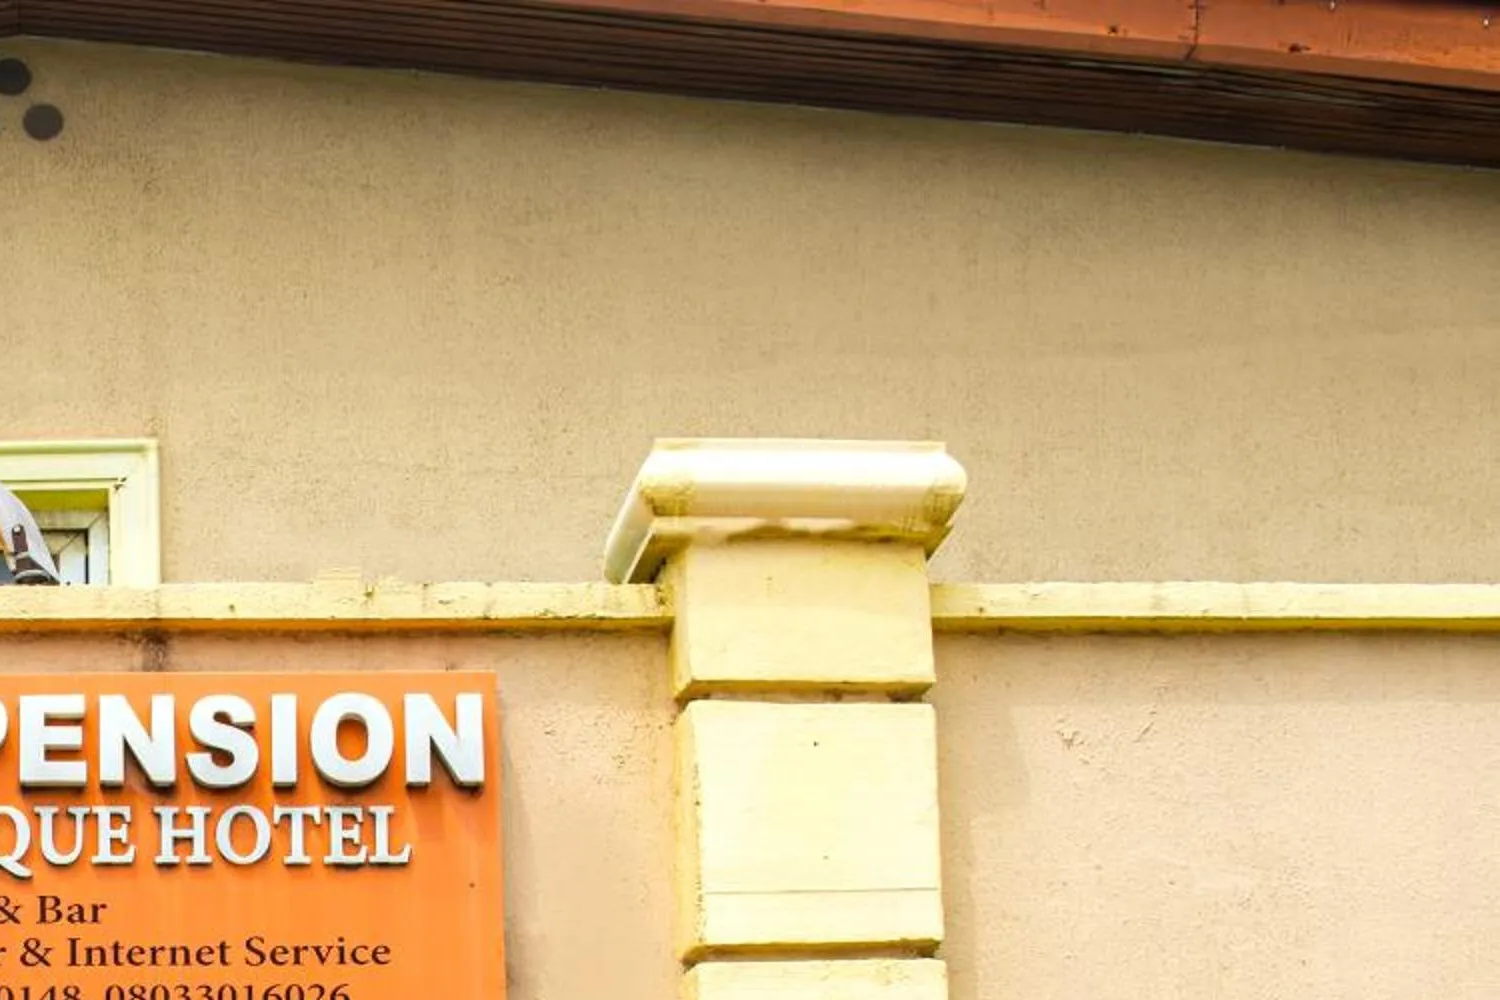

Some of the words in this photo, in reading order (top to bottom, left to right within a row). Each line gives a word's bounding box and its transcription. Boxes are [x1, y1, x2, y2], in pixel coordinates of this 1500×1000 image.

[153, 804, 413, 866] HOTEL
[36, 895, 108, 925] Bar
[19, 938, 53, 968] &
[67, 937, 232, 967] Internet
[244, 936, 392, 967] Service
